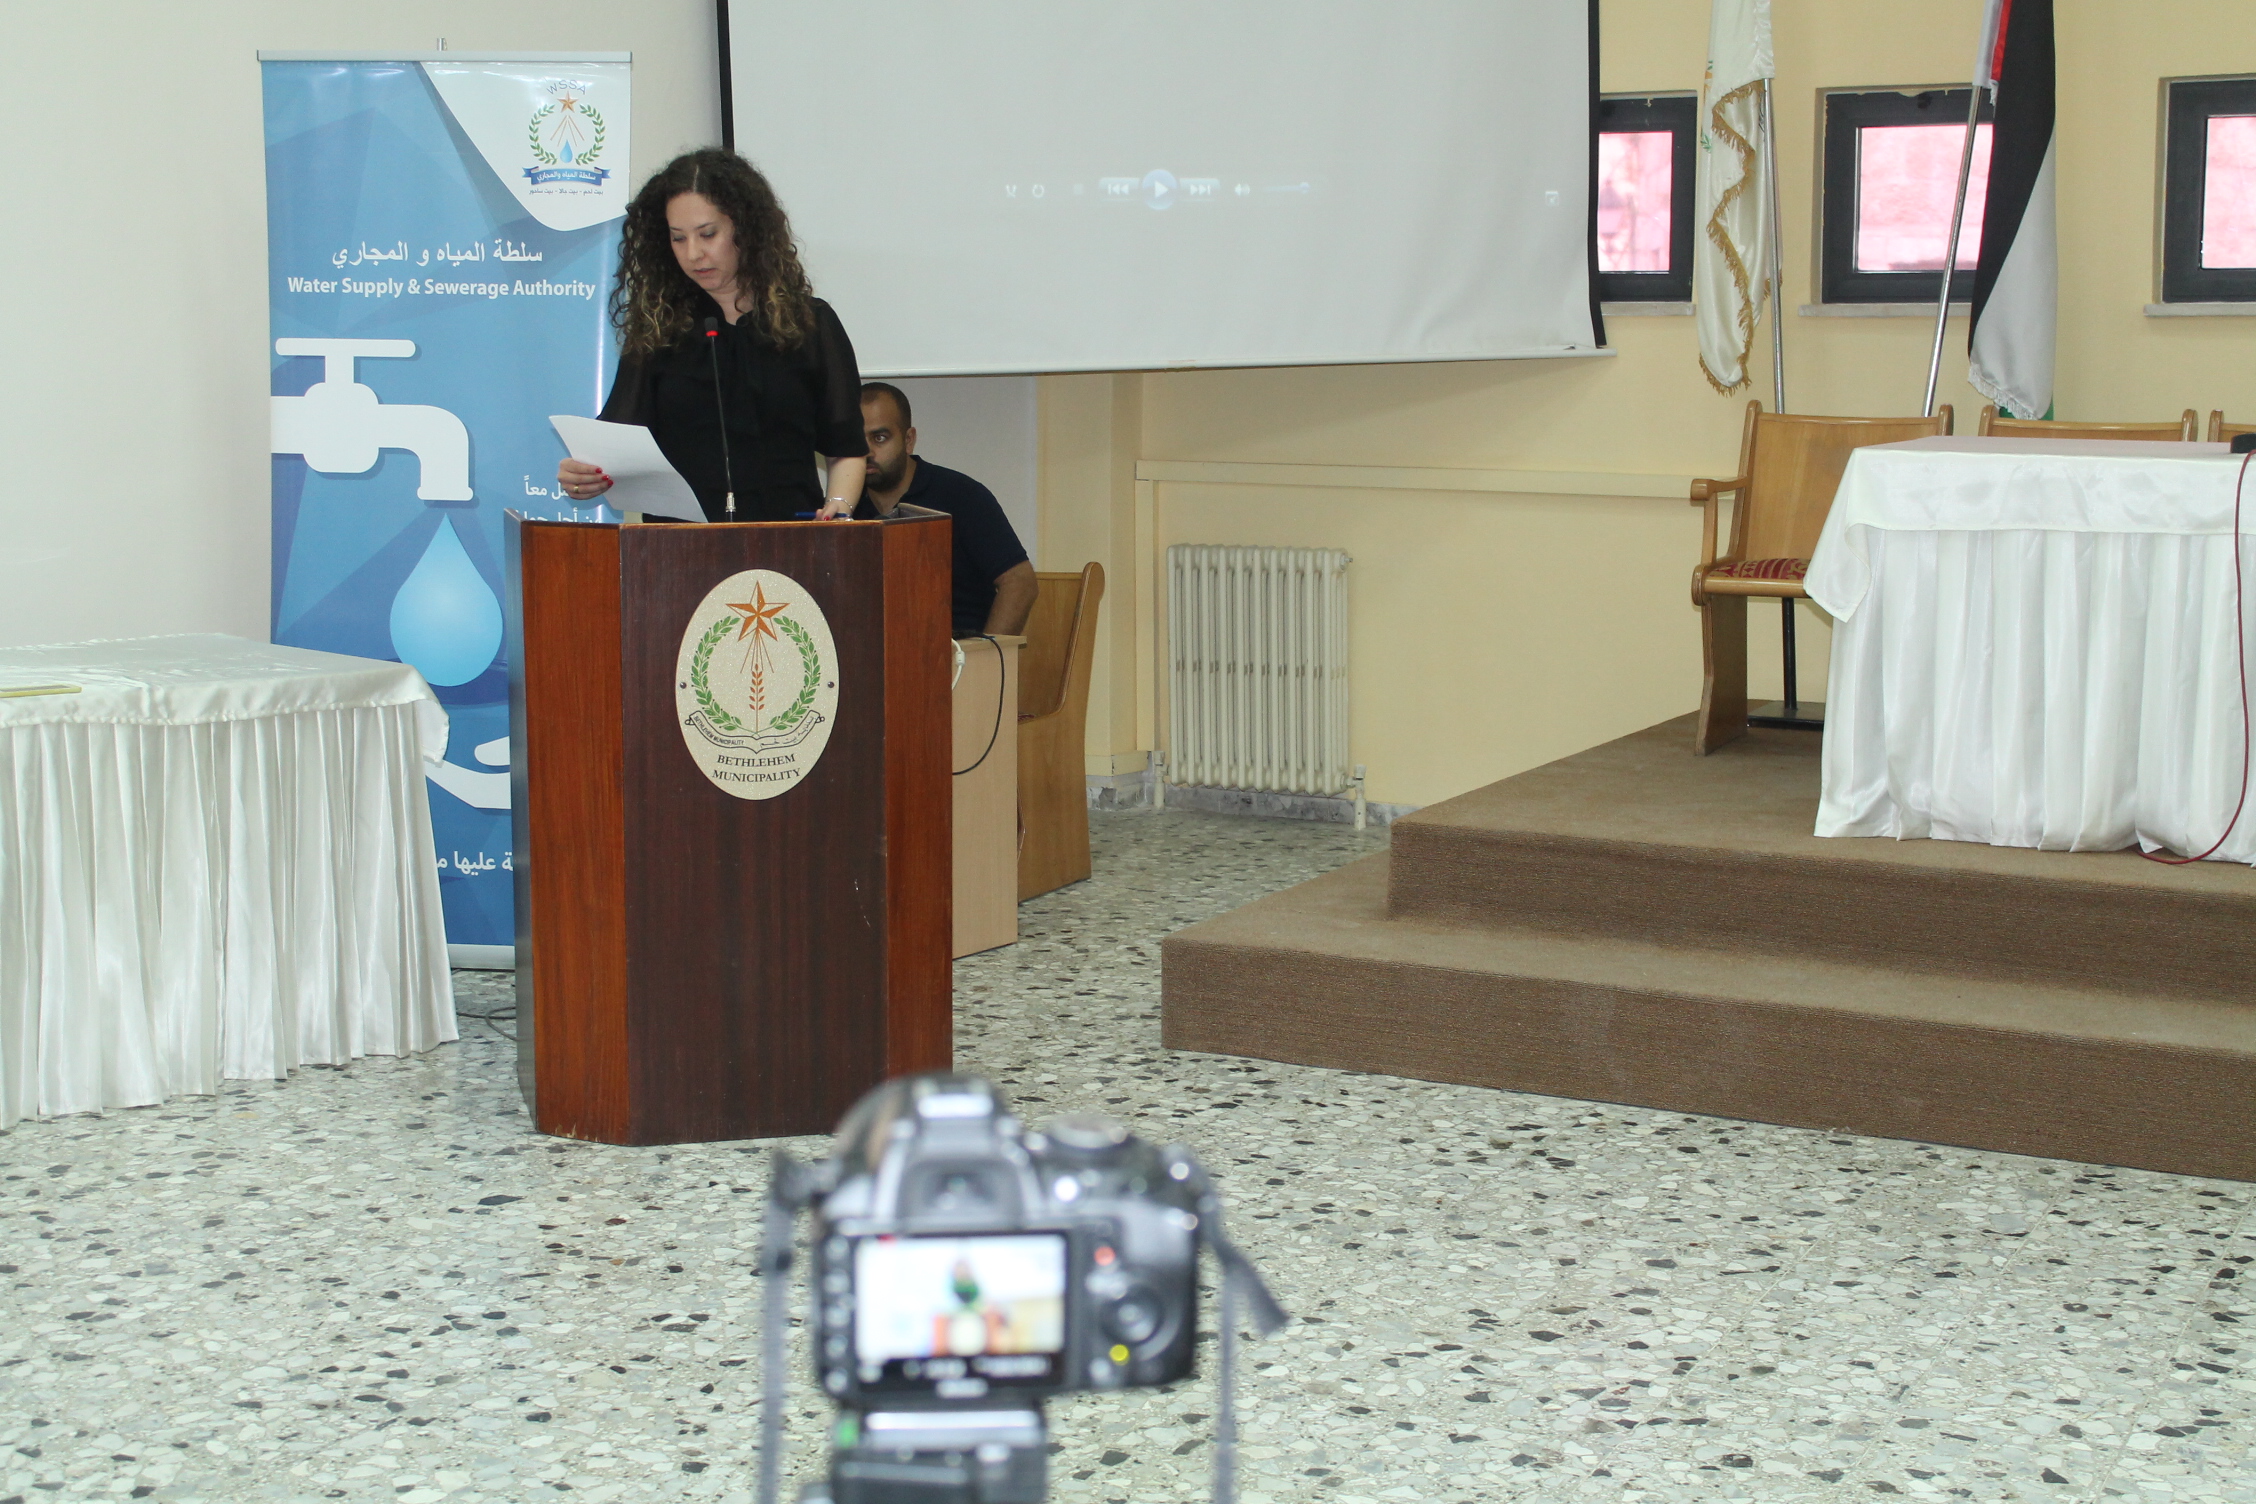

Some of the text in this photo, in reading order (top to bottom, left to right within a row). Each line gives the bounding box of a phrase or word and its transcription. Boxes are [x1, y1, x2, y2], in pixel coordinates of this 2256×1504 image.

[546, 80, 587, 96] WSSA
[332, 238, 543, 269] سلطة المياه و المجاري
[287, 276, 596, 301] Water Supply & Sewerage Authority
[717, 753, 796, 767] BETHLEHEM
[712, 768, 801, 783] MUNICIPALITY
[453, 850, 497, 876] عليها
